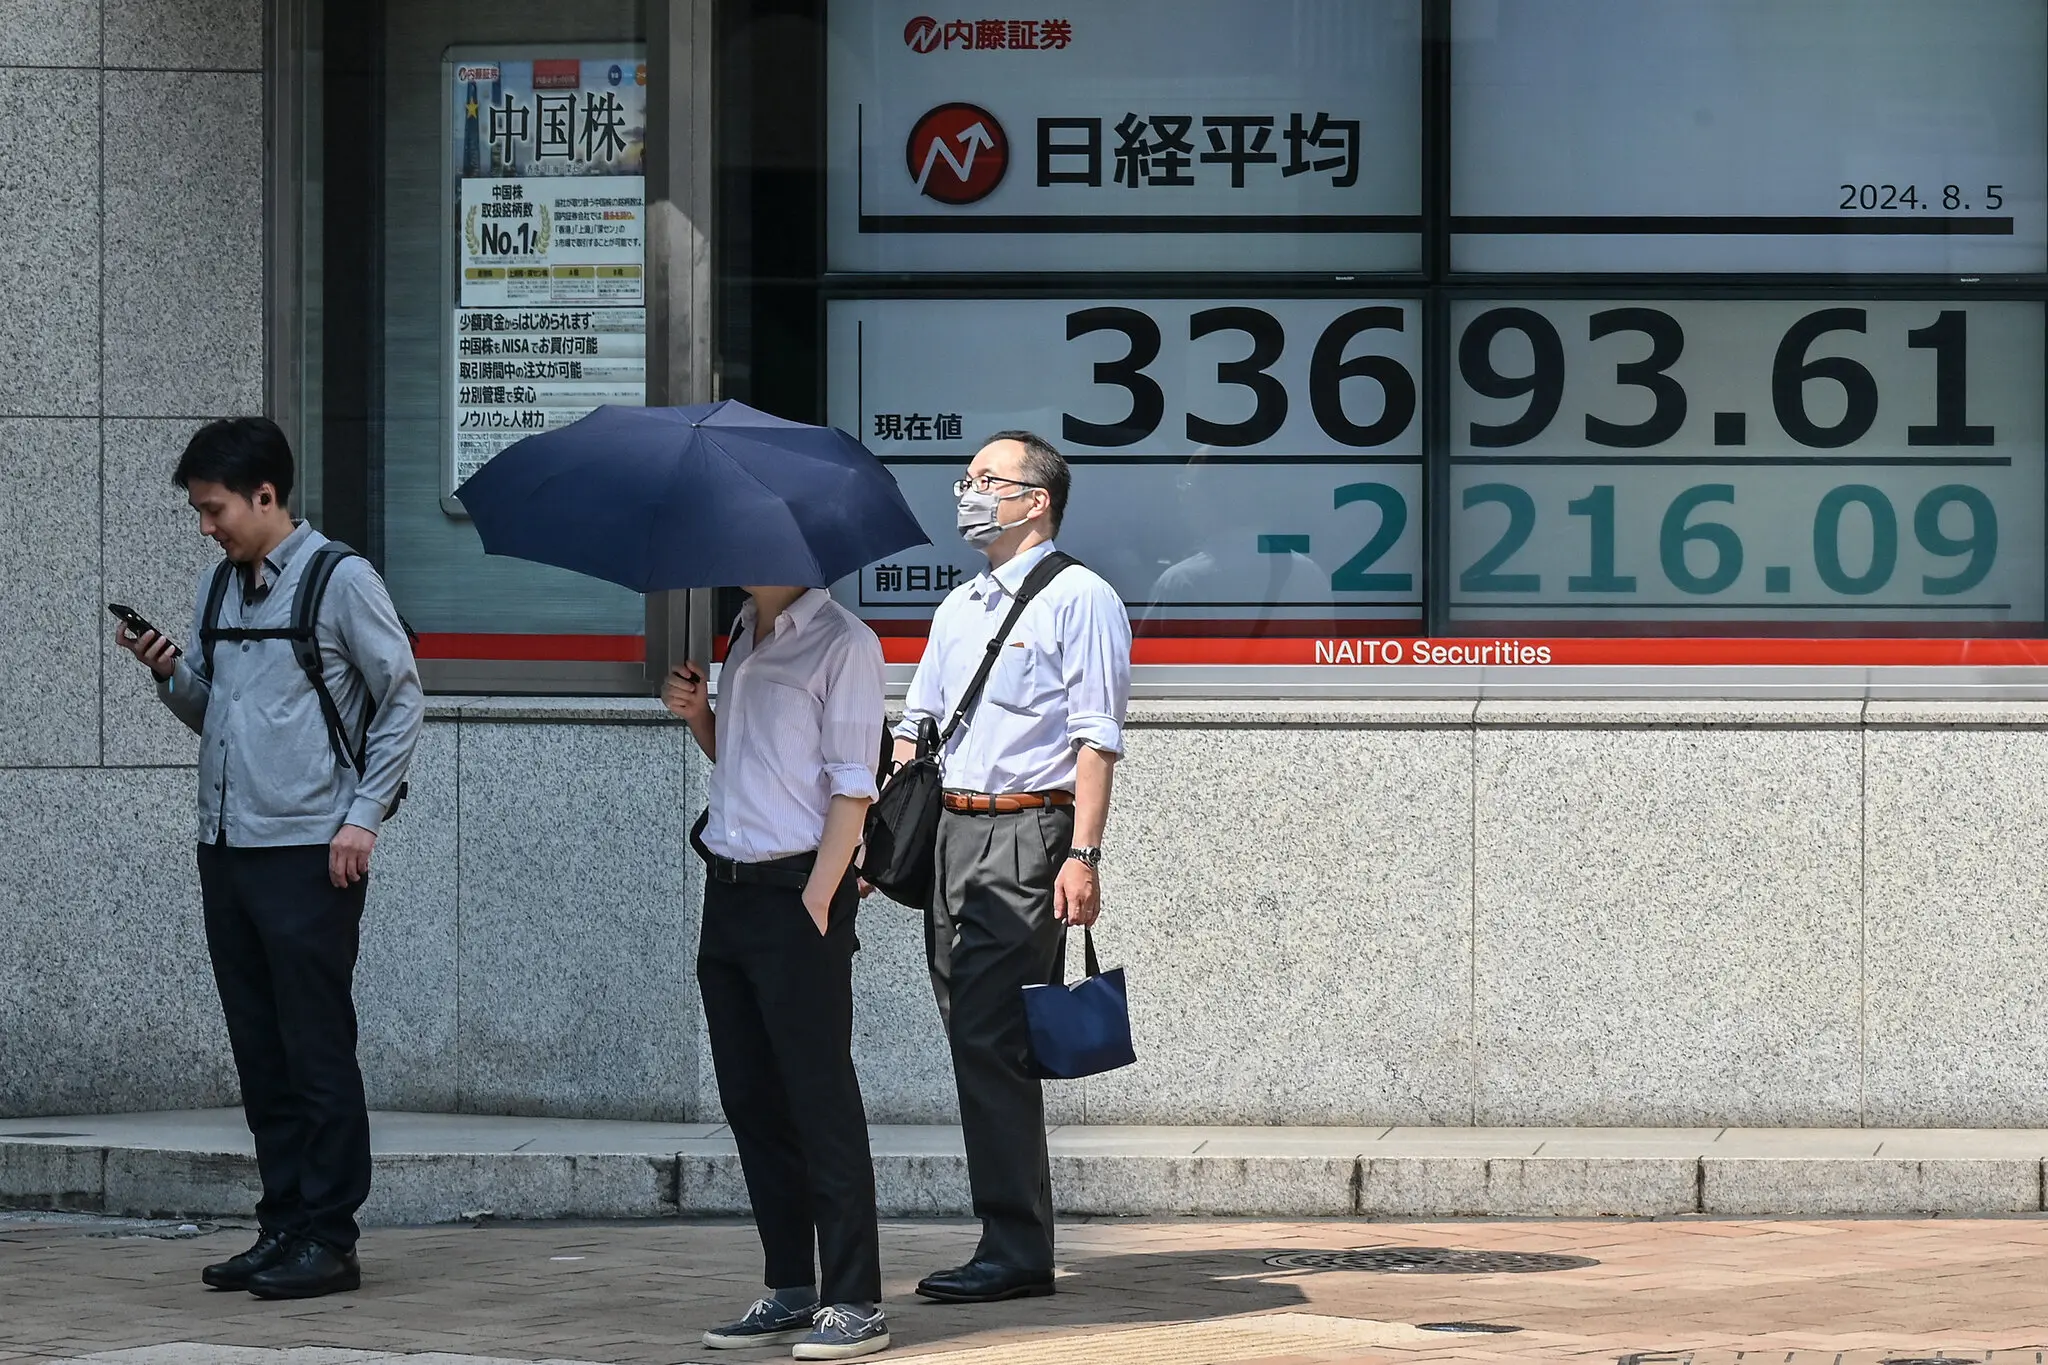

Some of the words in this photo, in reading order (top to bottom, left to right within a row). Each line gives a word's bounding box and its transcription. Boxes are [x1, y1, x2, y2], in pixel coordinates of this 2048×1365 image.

[943, 19, 1072, 50] 内藤証券
[489, 91, 627, 164] 中国株
[1036, 111, 1361, 189] 日経平均
[492, 184, 523, 200] 中国株
[1839, 184, 1928, 210] 2024.
[481, 202, 534, 218] 取扱銘柄数
[481, 222, 538, 256] No.1!
[460, 361, 582, 380] 取引時間中の注文が可能
[460, 386, 537, 404] 分別管理で安心
[460, 410, 545, 428] ノウハウと人材力
[874, 413, 963, 441] 現在値
[874, 564, 963, 592] 前日比
[1315, 640, 1403, 664] NAITO
[1412, 640, 1552, 664] Securities
